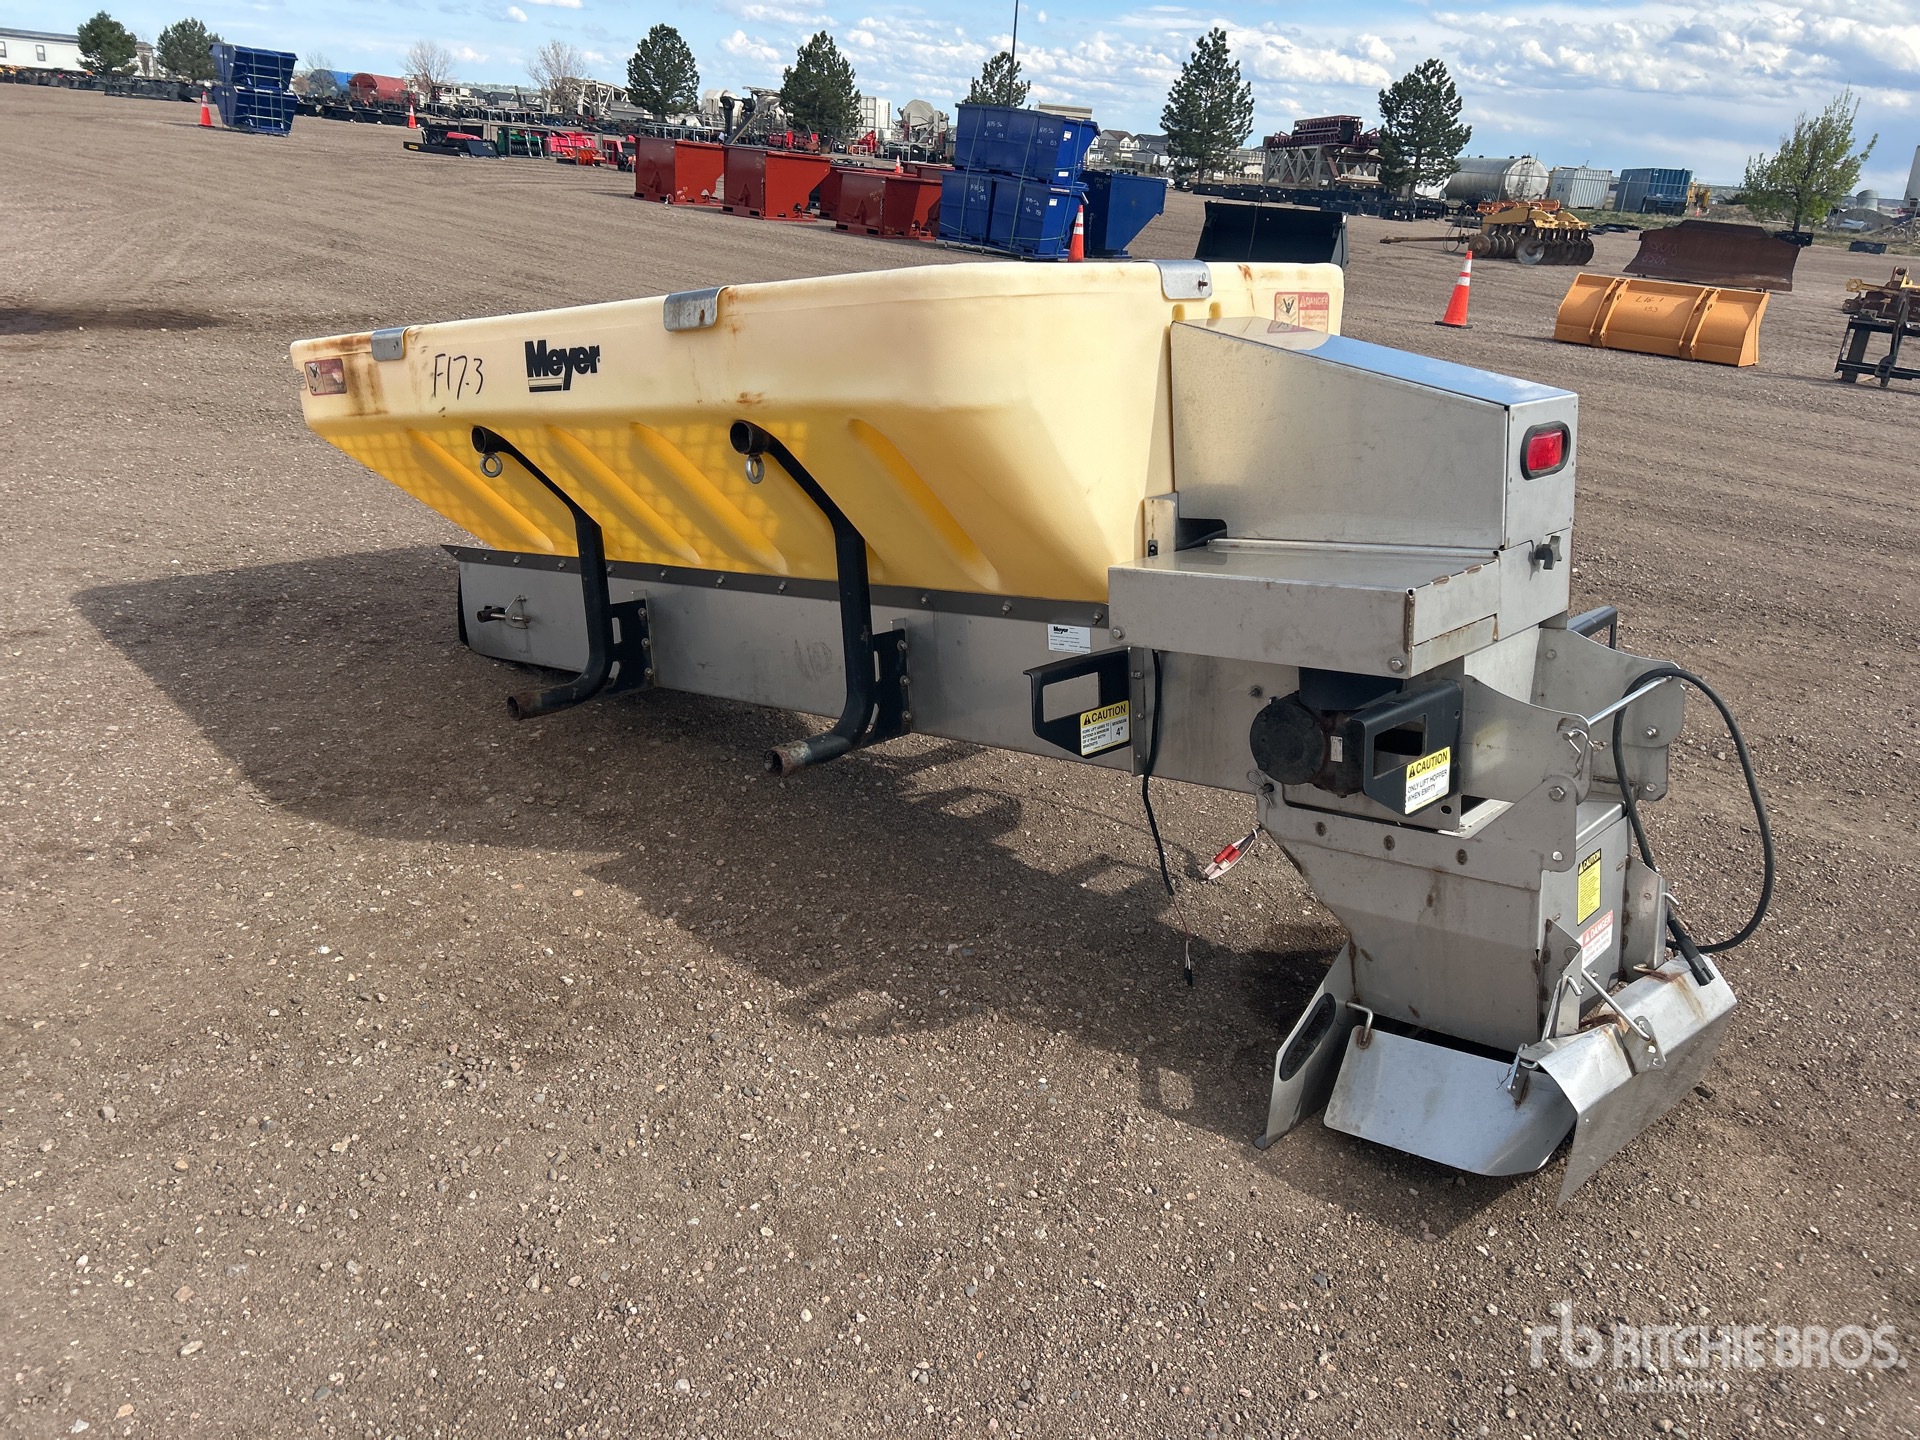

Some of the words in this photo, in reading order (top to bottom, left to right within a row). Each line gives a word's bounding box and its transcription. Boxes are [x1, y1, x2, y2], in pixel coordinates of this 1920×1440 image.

[1305, 296, 1329, 306] DANGER
[524, 339, 600, 391] Meyer
[433, 353, 484, 401] F17.3
[1091, 704, 1126, 722] CAUTION
[1112, 718, 1127, 726] MINIMUM
[1415, 750, 1448, 774] CAUTION
[1407, 781, 1420, 793] ONLY
[1420, 777, 1430, 788] LIFT
[1430, 768, 1447, 782] HOPPER
[1407, 791, 1421, 802] WHEN
[1421, 784, 1436, 796] EMPTY
[1583, 850, 1600, 870] CAUTION
[1590, 914, 1611, 940] DANGER
